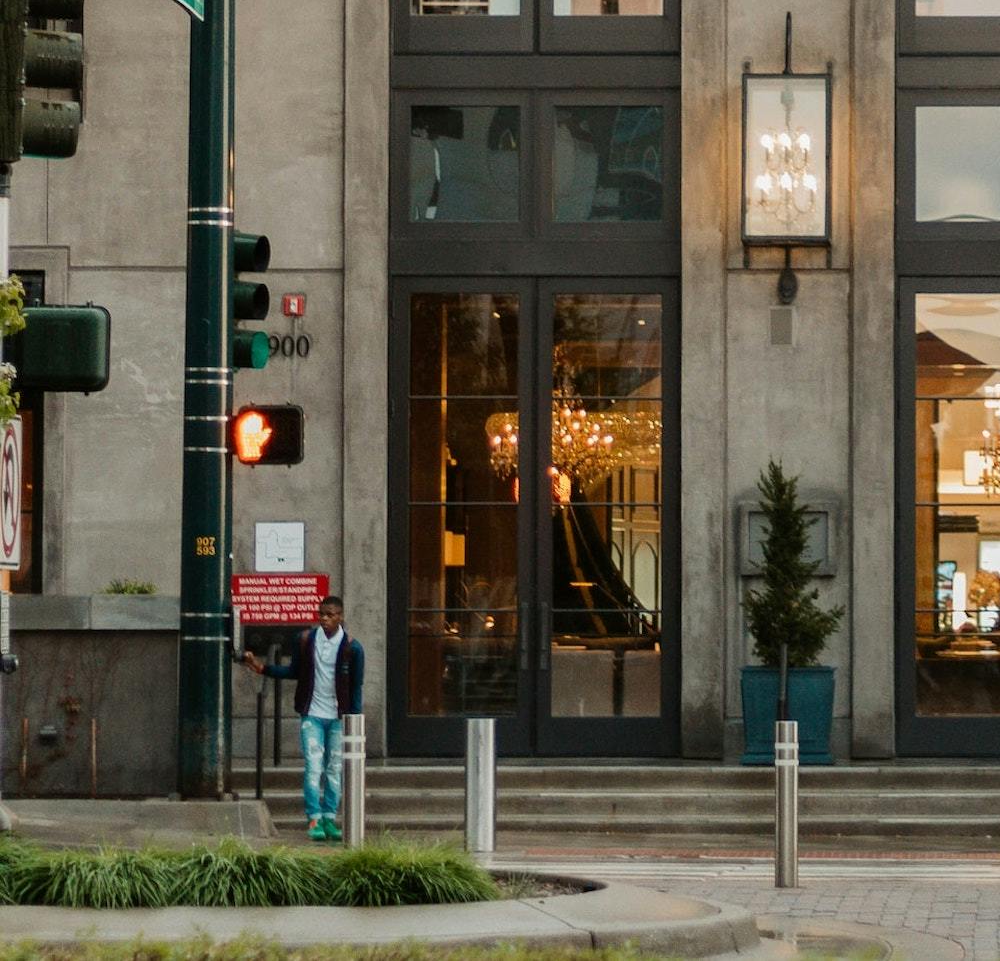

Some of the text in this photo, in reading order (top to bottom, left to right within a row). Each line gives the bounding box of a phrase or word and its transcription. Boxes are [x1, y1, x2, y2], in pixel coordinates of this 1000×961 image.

[196, 536, 216, 546] 907
[238, 577, 318, 586] MANUAL WET COMBINE
[232, 595, 325, 603] SYSTEM REQUIRED SUPPLY
[260, 604, 273, 612] PSI
[281, 604, 296, 612] TOP
[297, 604, 321, 612] OUTLE
[264, 613, 280, 621] GPM
[301, 613, 314, 621] PSI
